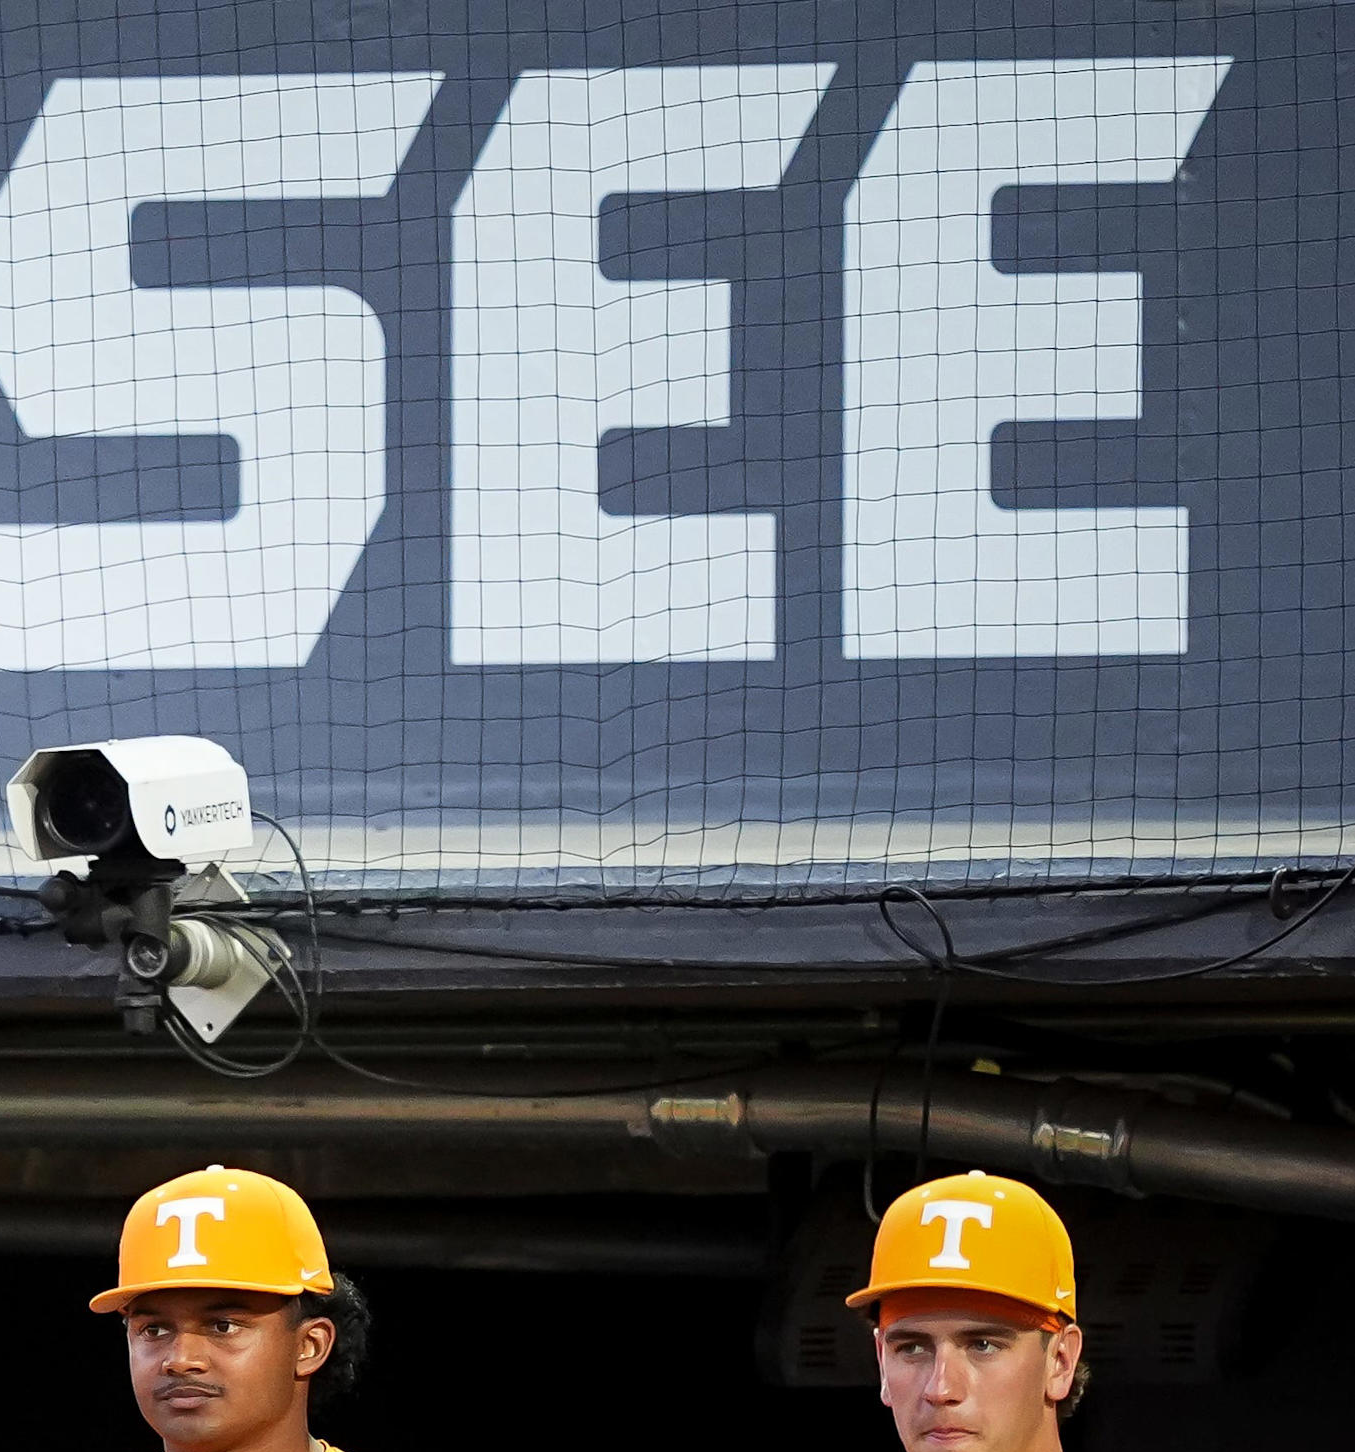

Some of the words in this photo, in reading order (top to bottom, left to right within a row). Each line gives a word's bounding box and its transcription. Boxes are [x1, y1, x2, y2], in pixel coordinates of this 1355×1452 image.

[179, 799, 245, 828] YAKKERTECH
[151, 1194, 228, 1270] T
[919, 1198, 994, 1270] T
